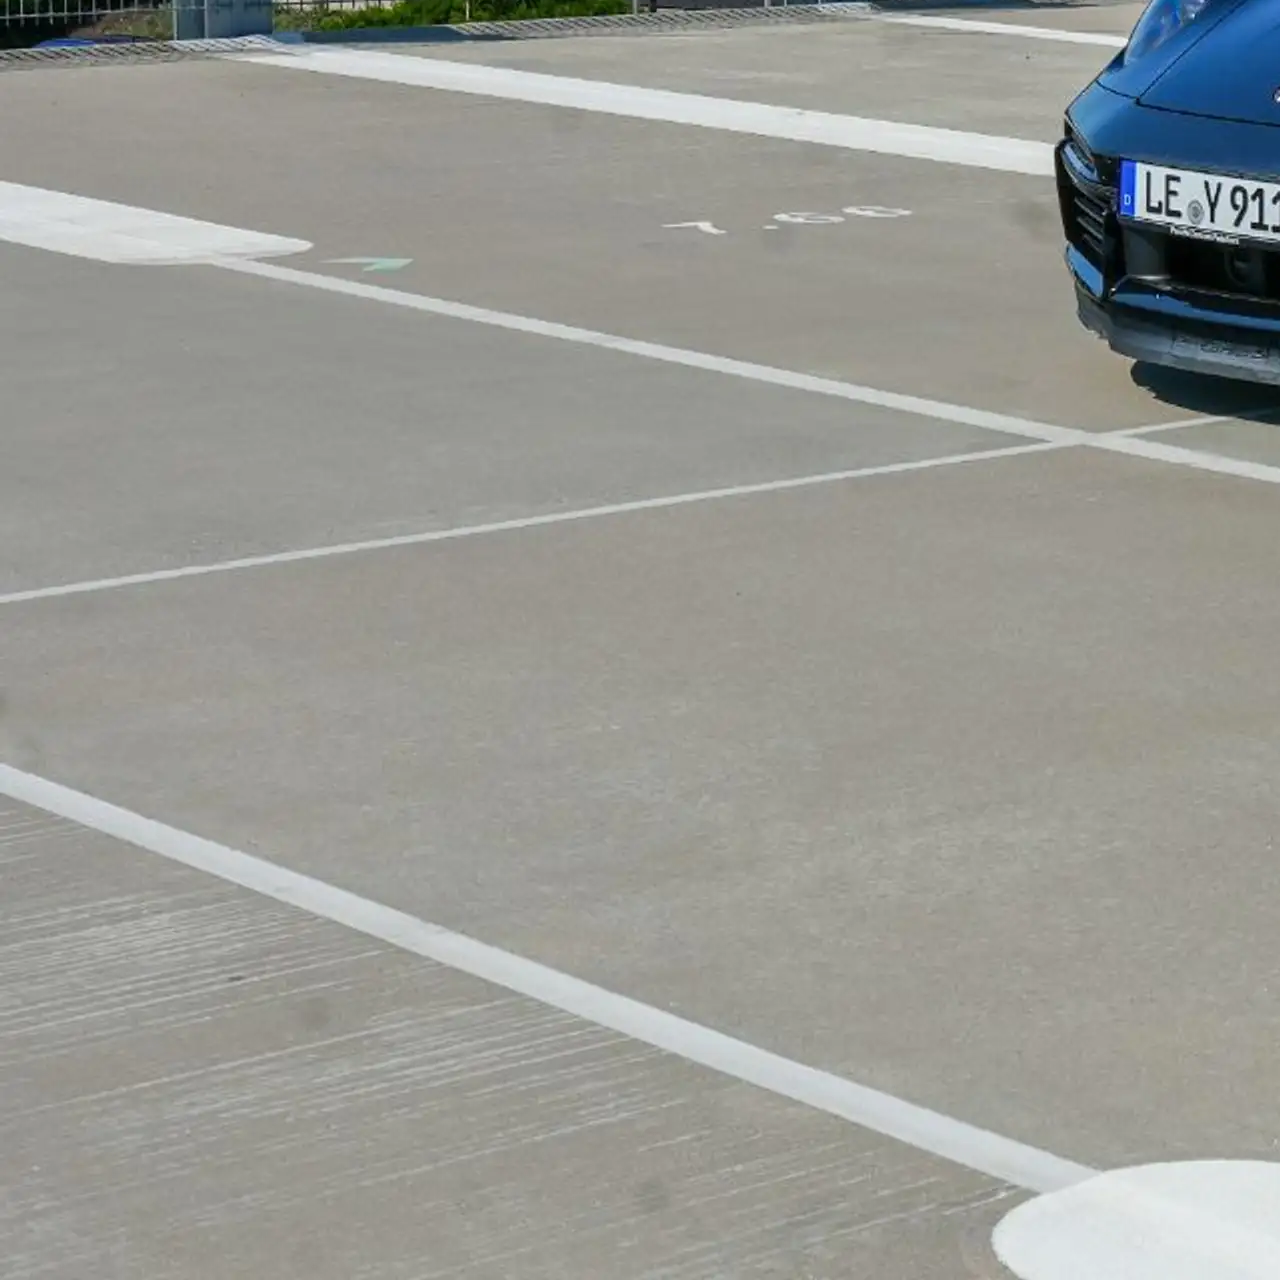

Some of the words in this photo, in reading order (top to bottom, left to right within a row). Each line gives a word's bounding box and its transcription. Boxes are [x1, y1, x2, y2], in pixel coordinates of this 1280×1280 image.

[1124, 193, 1131, 206] D
[1145, 171, 1182, 218] LE
[1204, 179, 1222, 223] Y
